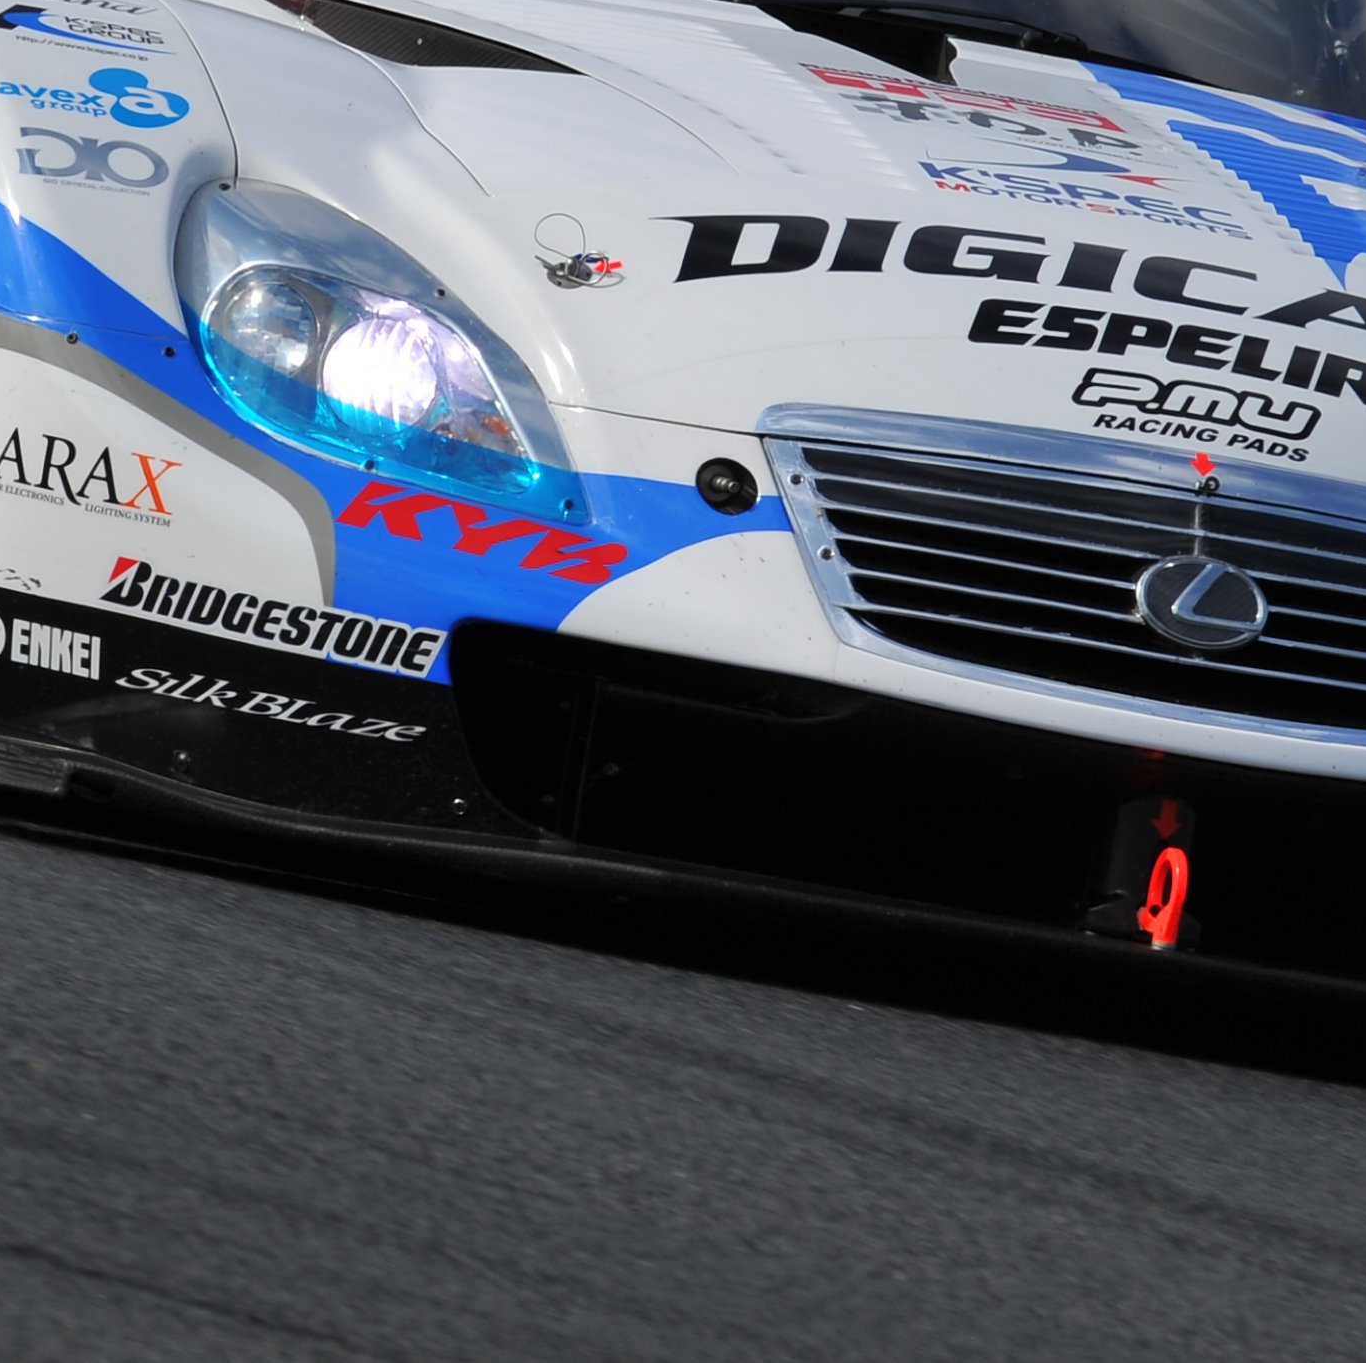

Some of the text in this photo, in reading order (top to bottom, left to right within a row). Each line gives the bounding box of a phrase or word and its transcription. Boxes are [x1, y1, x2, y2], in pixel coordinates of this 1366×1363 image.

[68, 24, 165, 46] GROUP
[30, 98, 108, 118] group
[807, 68, 1128, 133] TRD
[918, 161, 1244, 231] K'SPEC
[1092, 413, 1311, 463] RACING PADS
[4, 484, 65, 507] ELECTRONICS
[84, 502, 133, 521] LIGHTING
[134, 512, 172, 529] SYSTEM
[335, 480, 629, 585] KYB
[99, 555, 442, 674] BRIDGESTONE
[10, 618, 102, 681] ENKEI
